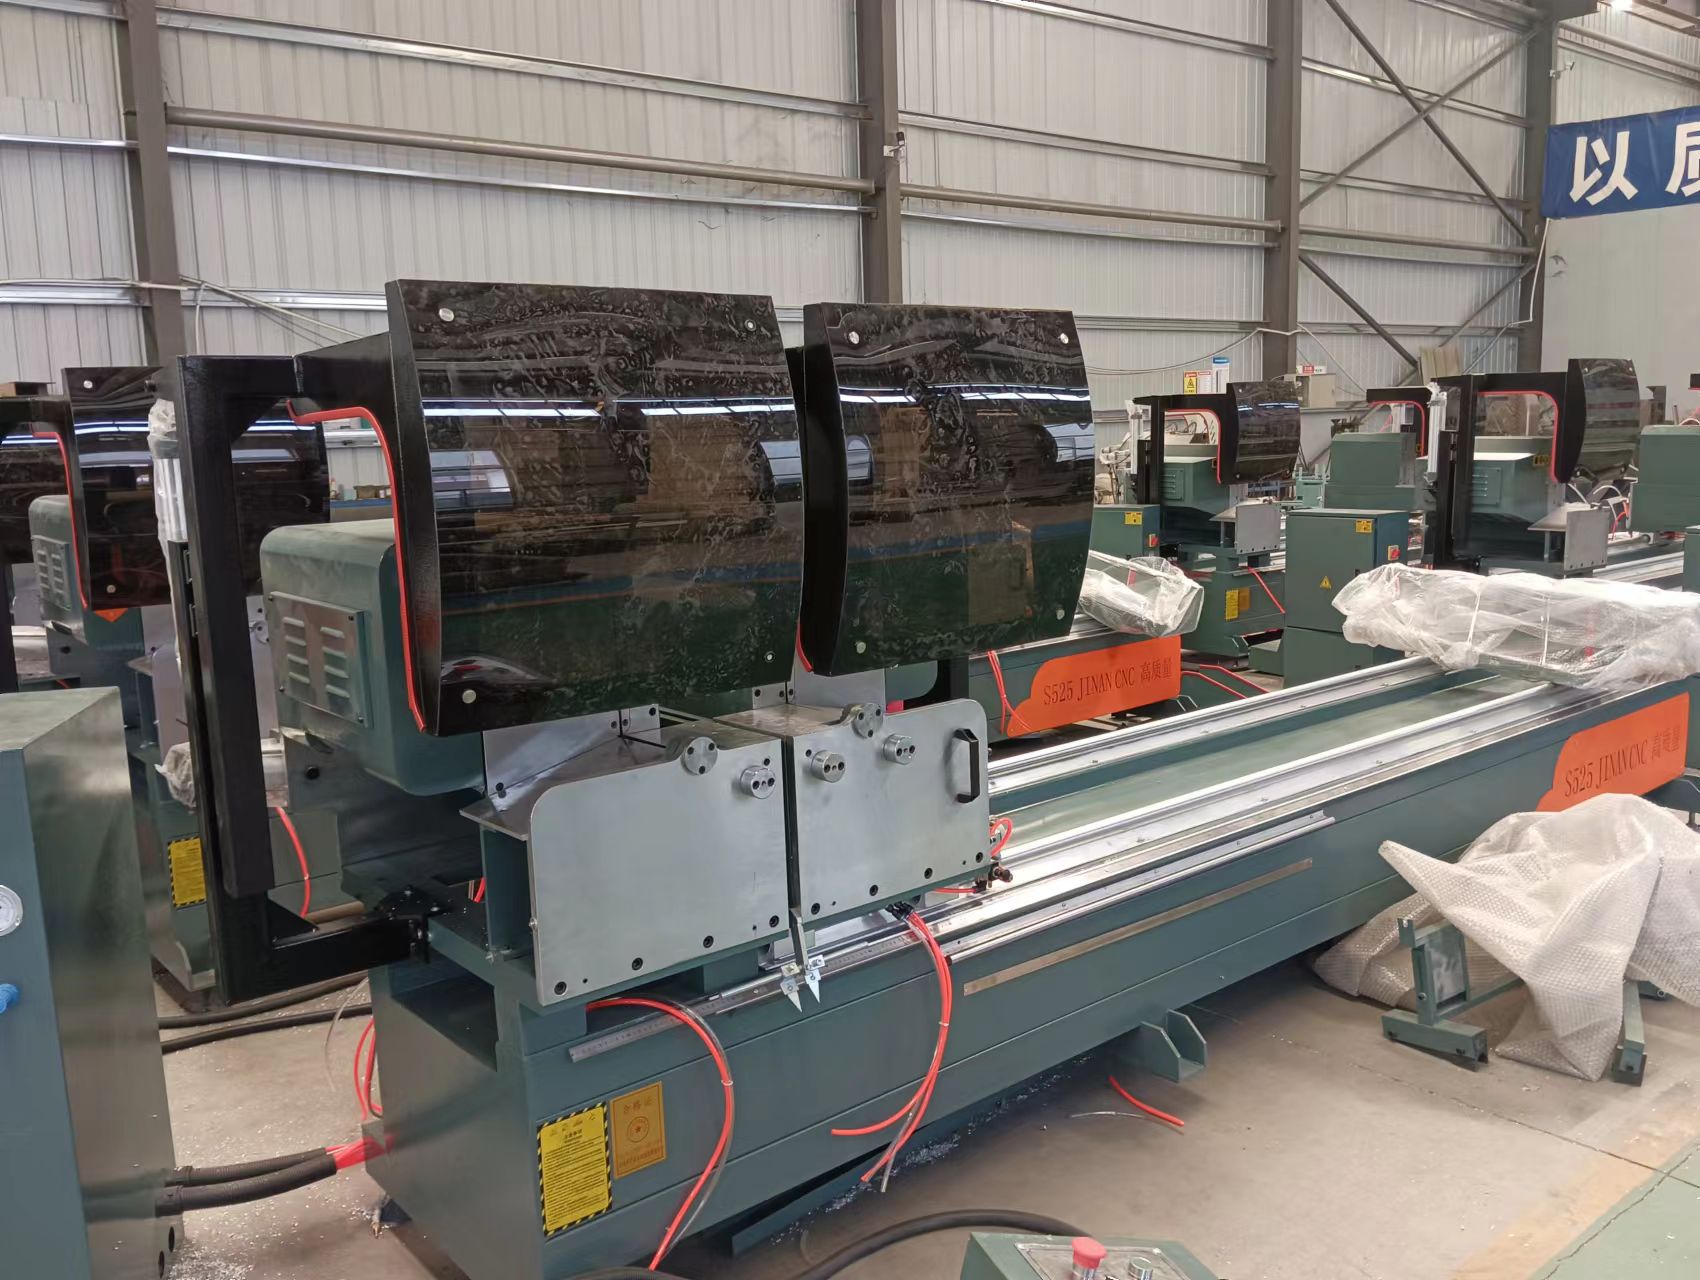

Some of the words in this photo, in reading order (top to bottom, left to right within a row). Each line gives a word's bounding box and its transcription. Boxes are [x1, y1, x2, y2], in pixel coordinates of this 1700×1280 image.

[1043, 680, 1074, 705] S525
[1077, 673, 1113, 702] JINAN
[1114, 666, 1137, 688] CNC
[1140, 657, 1172, 682] 高质量
[1565, 762, 1593, 797] S525
[1596, 749, 1628, 789] JINAN
[1629, 739, 1648, 770] CNC
